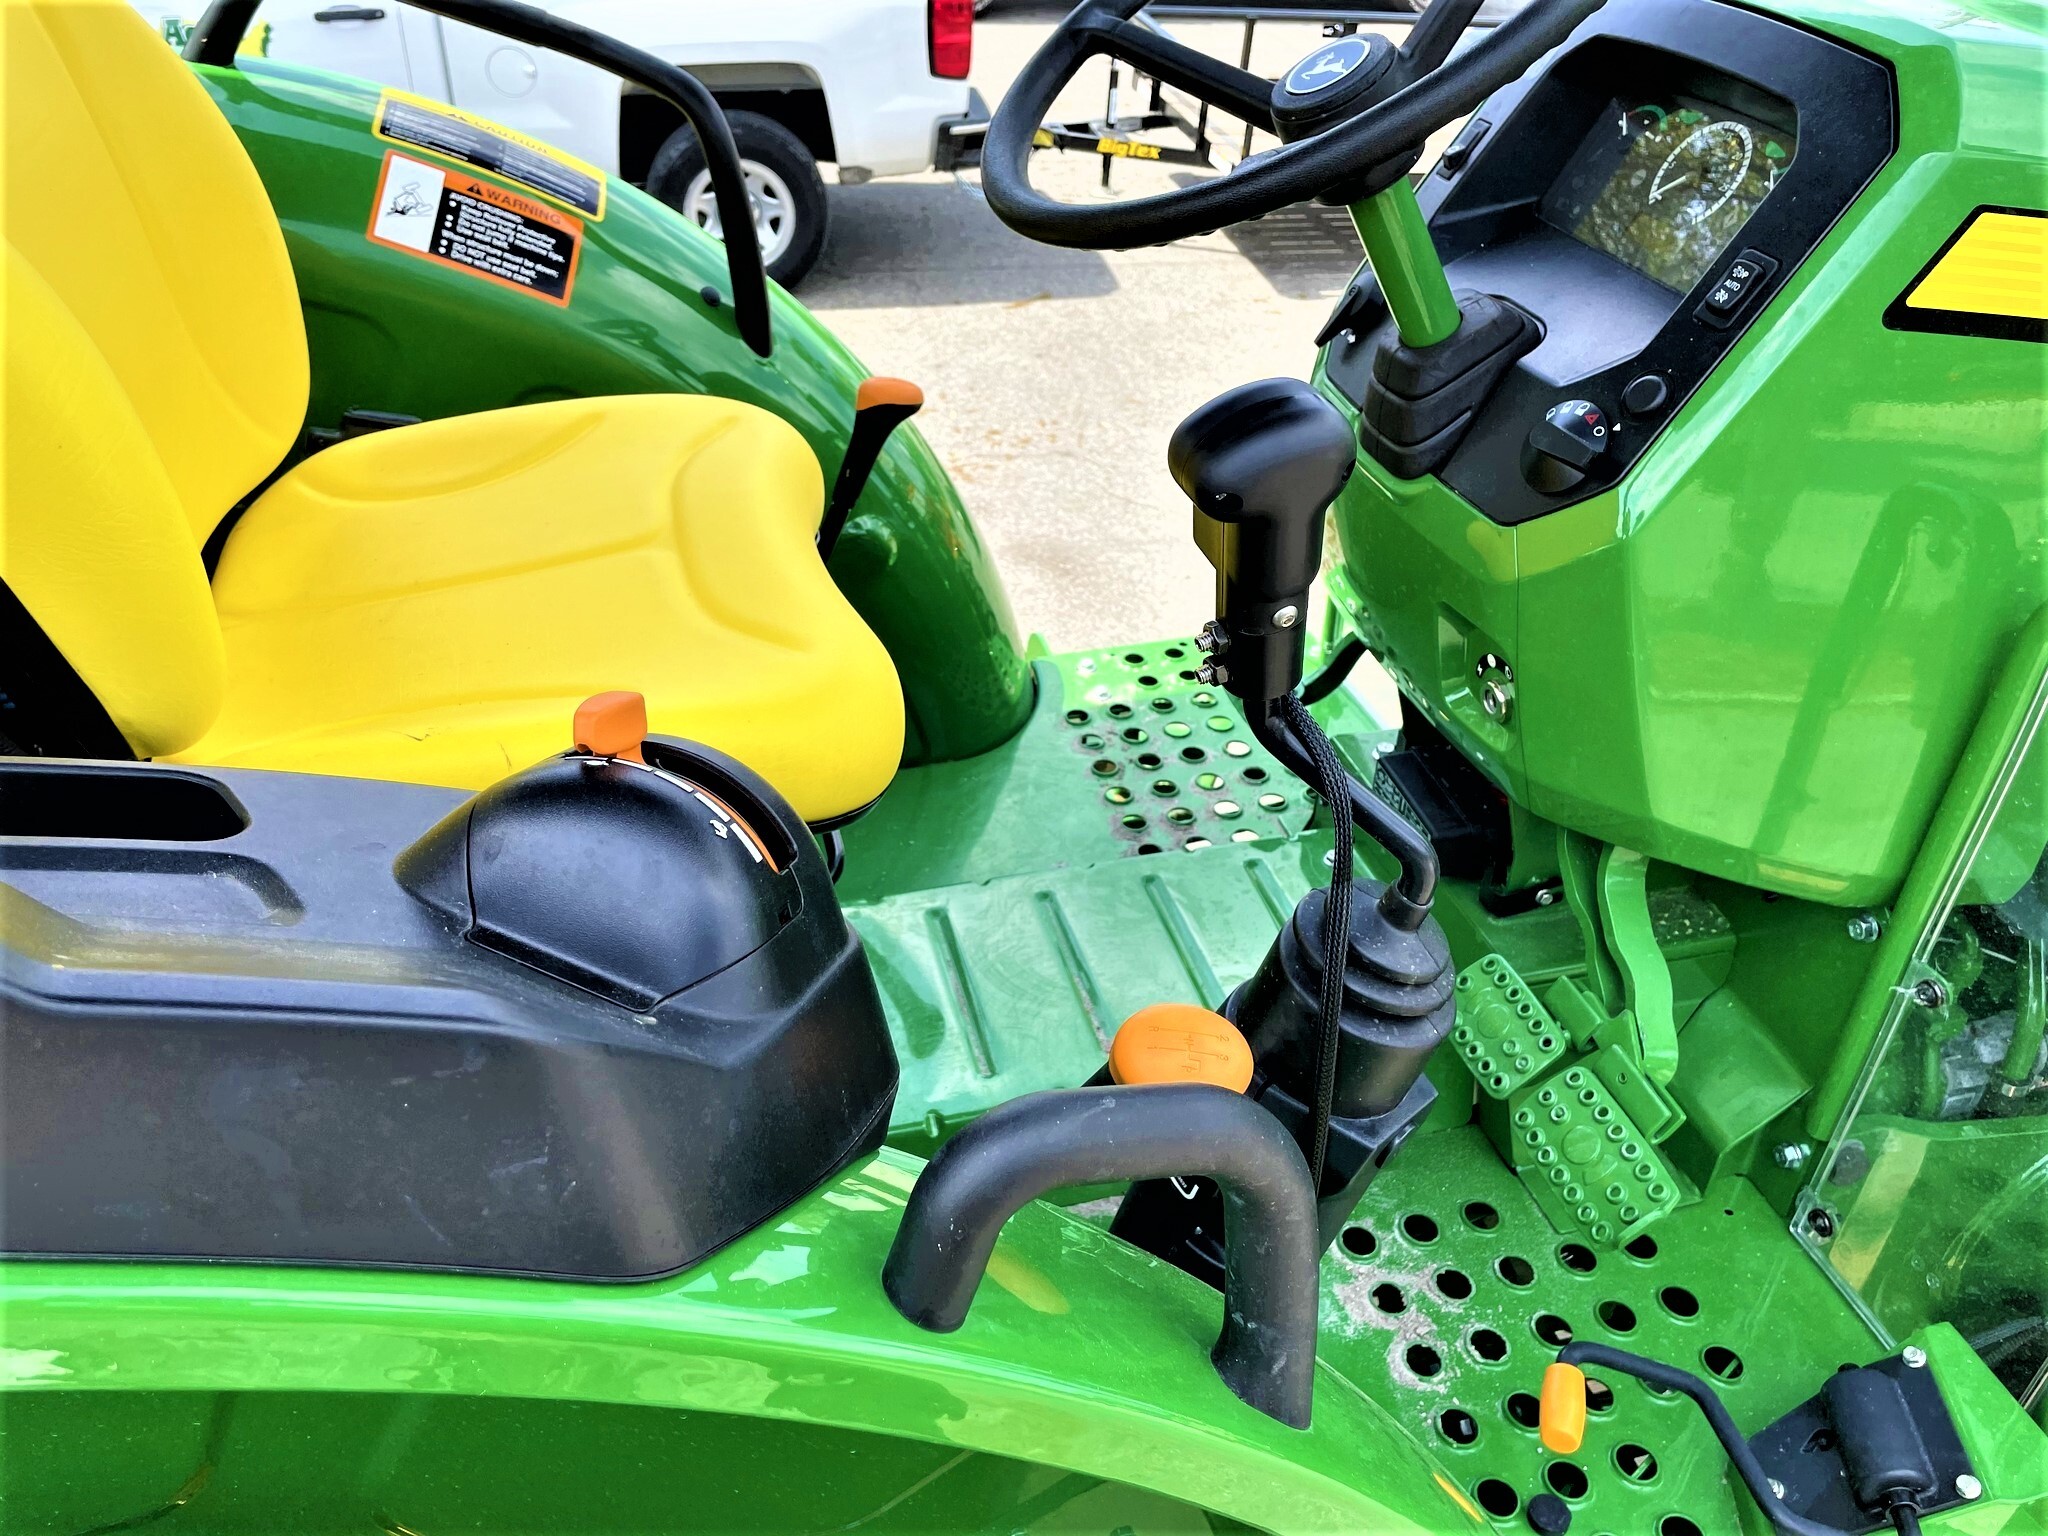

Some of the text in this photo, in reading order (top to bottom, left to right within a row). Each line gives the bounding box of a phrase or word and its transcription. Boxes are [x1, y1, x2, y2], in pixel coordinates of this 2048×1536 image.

[449, 192, 477, 207] AVOID
[486, 188, 561, 225] WARNING
[441, 229, 466, 244] When
[1723, 278, 1741, 292] AUTO
[1219, 1034, 1230, 1042] 2
[1219, 1054, 1229, 1062] 3
